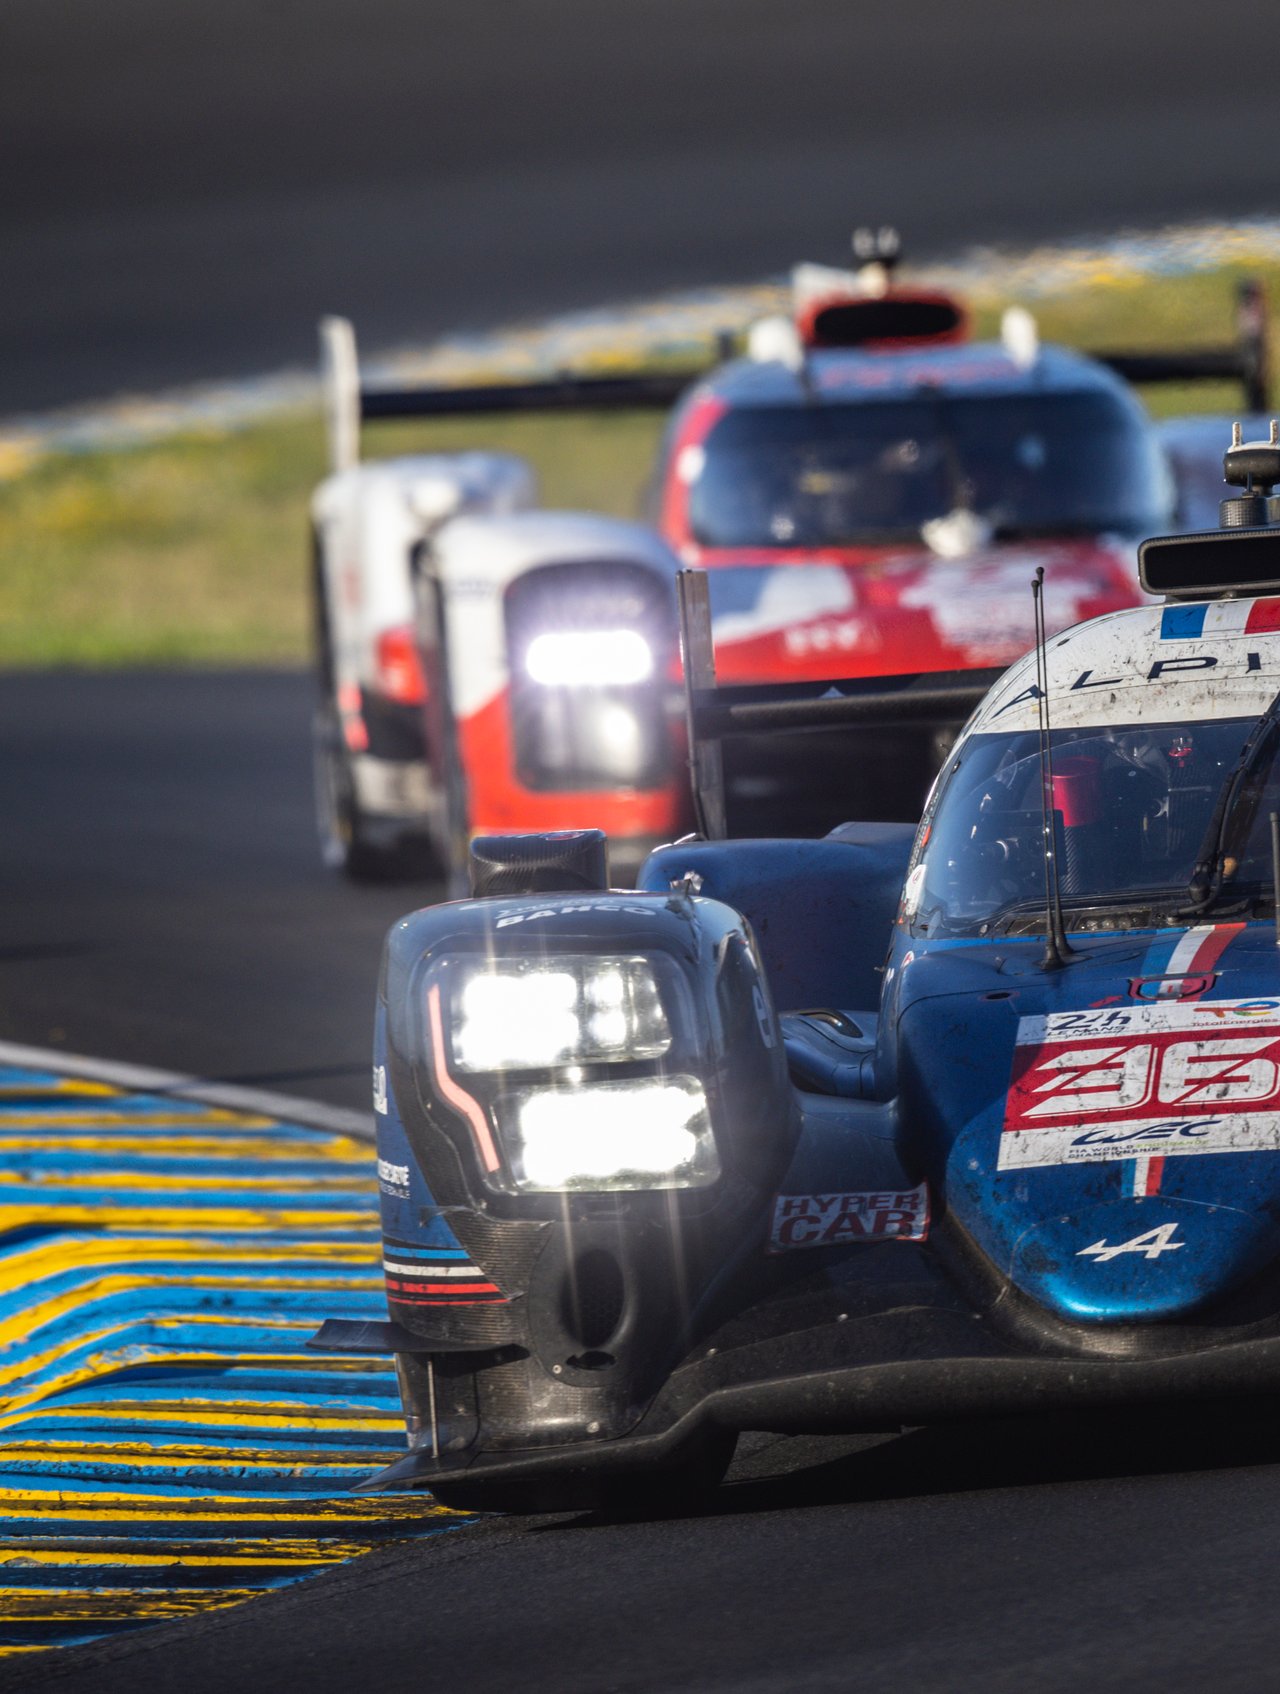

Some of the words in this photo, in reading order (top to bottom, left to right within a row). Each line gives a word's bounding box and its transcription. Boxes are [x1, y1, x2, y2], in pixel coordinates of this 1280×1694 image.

[496, 905, 656, 928] BAHCO
[1192, 1018, 1279, 1027] TotalEnergies
[1070, 1120, 1222, 1147] WEC
[1091, 1144, 1135, 1153] WORLD
[782, 1193, 920, 1217] HYPER
[779, 1209, 916, 1246] CAR
